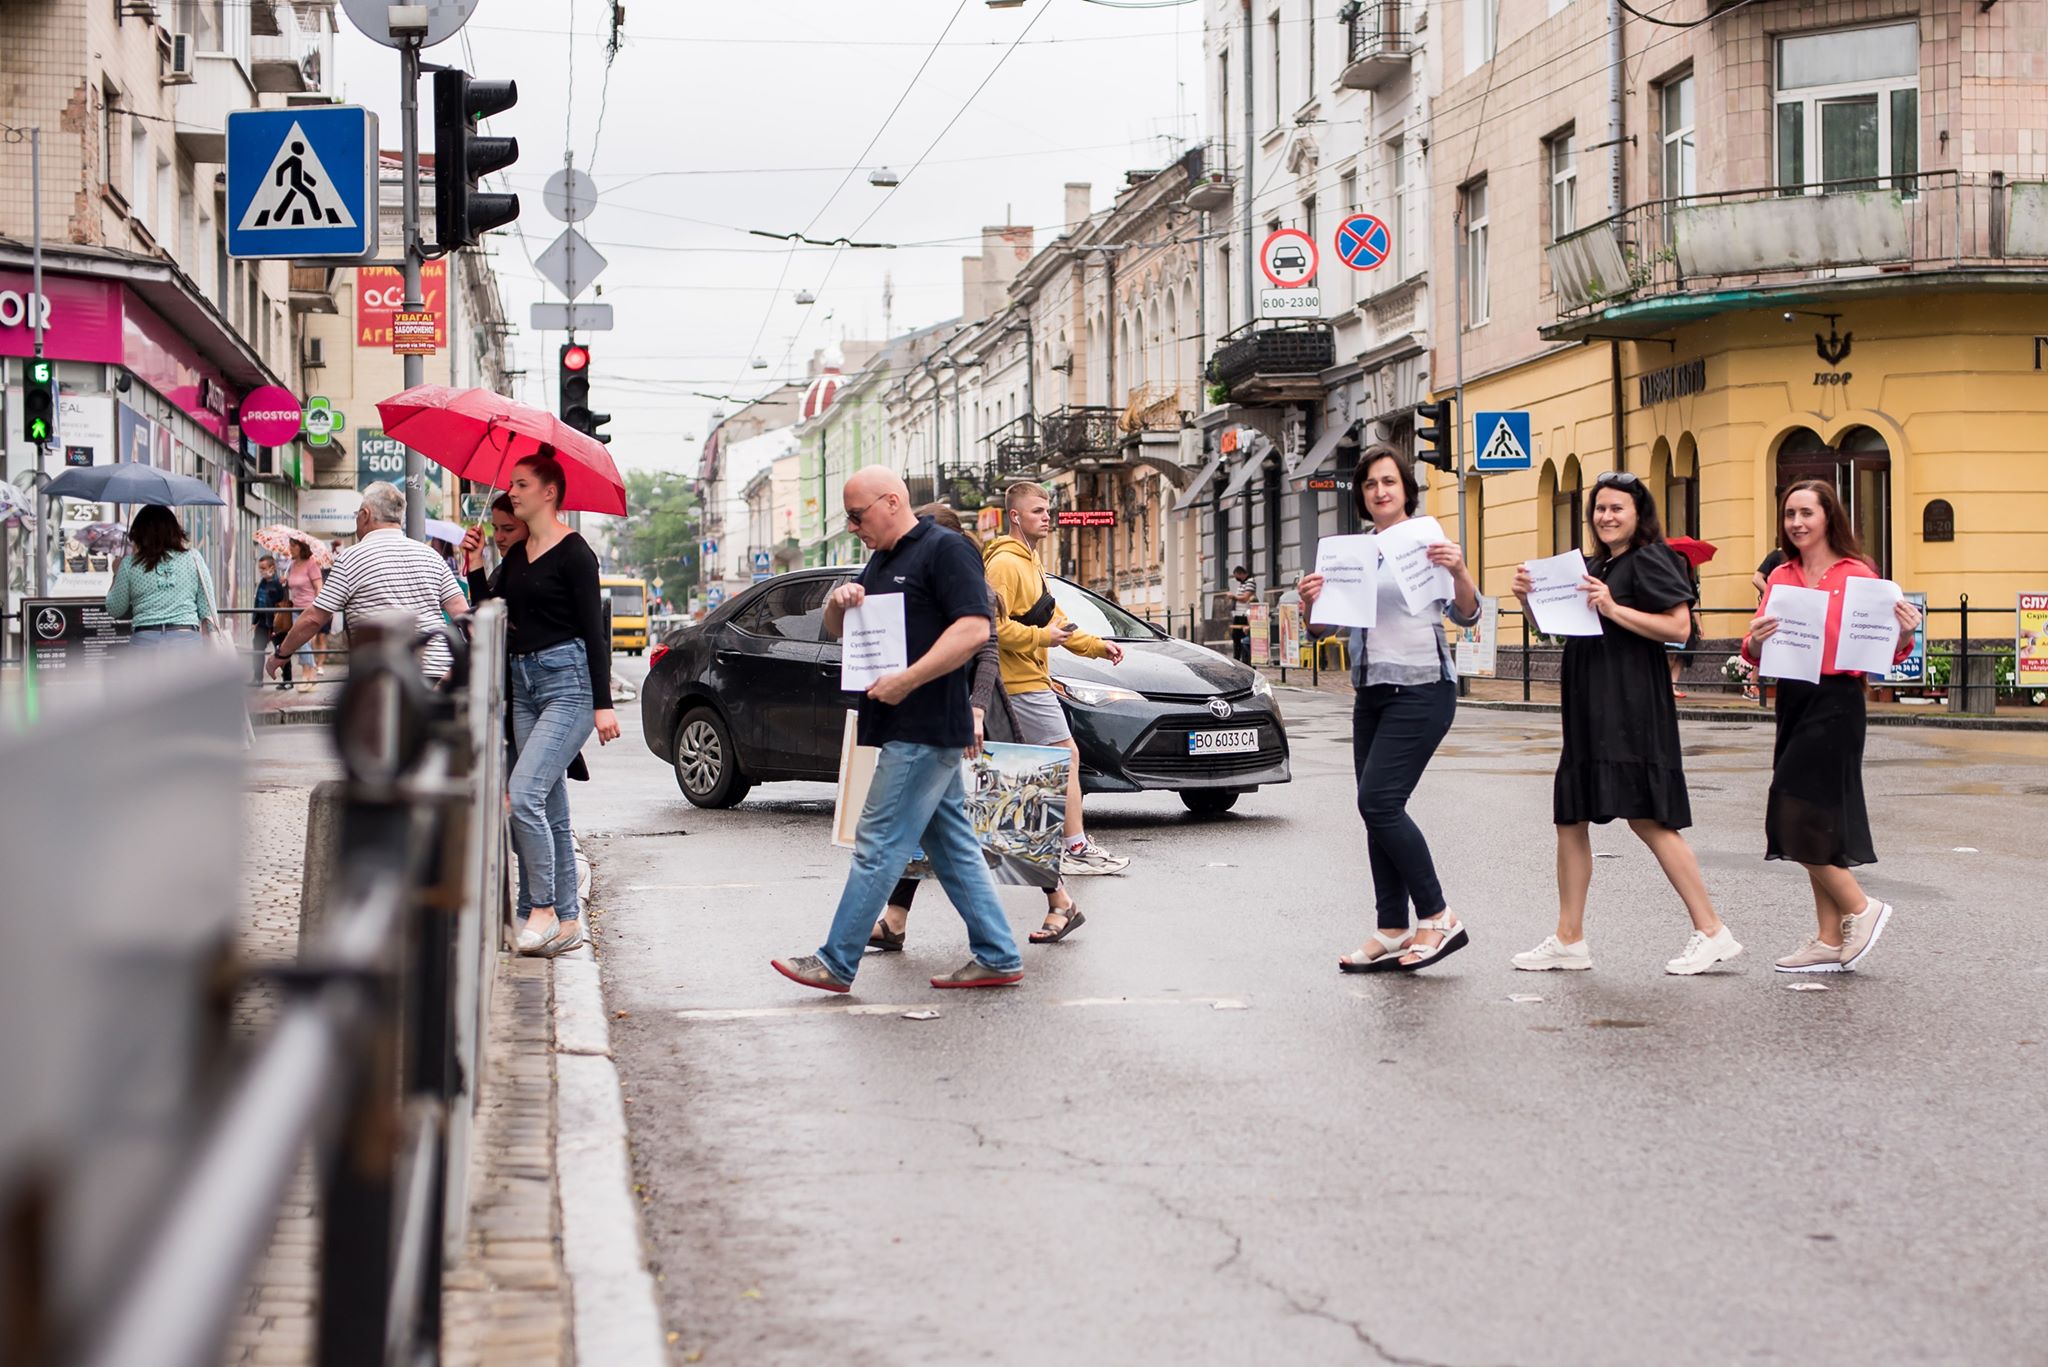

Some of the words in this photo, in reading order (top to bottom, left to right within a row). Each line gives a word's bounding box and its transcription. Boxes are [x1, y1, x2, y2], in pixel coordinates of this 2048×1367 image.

[0, 290, 52, 330] OR
[394, 313, 432, 322] УВАГА!
[361, 440, 406, 456] КРЕД
[1336, 480, 1346, 489] to
[1346, 482, 1353, 491] g
[2021, 596, 2048, 610] СЛУ
[1196, 733, 1213, 748] BO
[1215, 732, 1240, 747] 6033
[1241, 731, 1255, 746] CA
